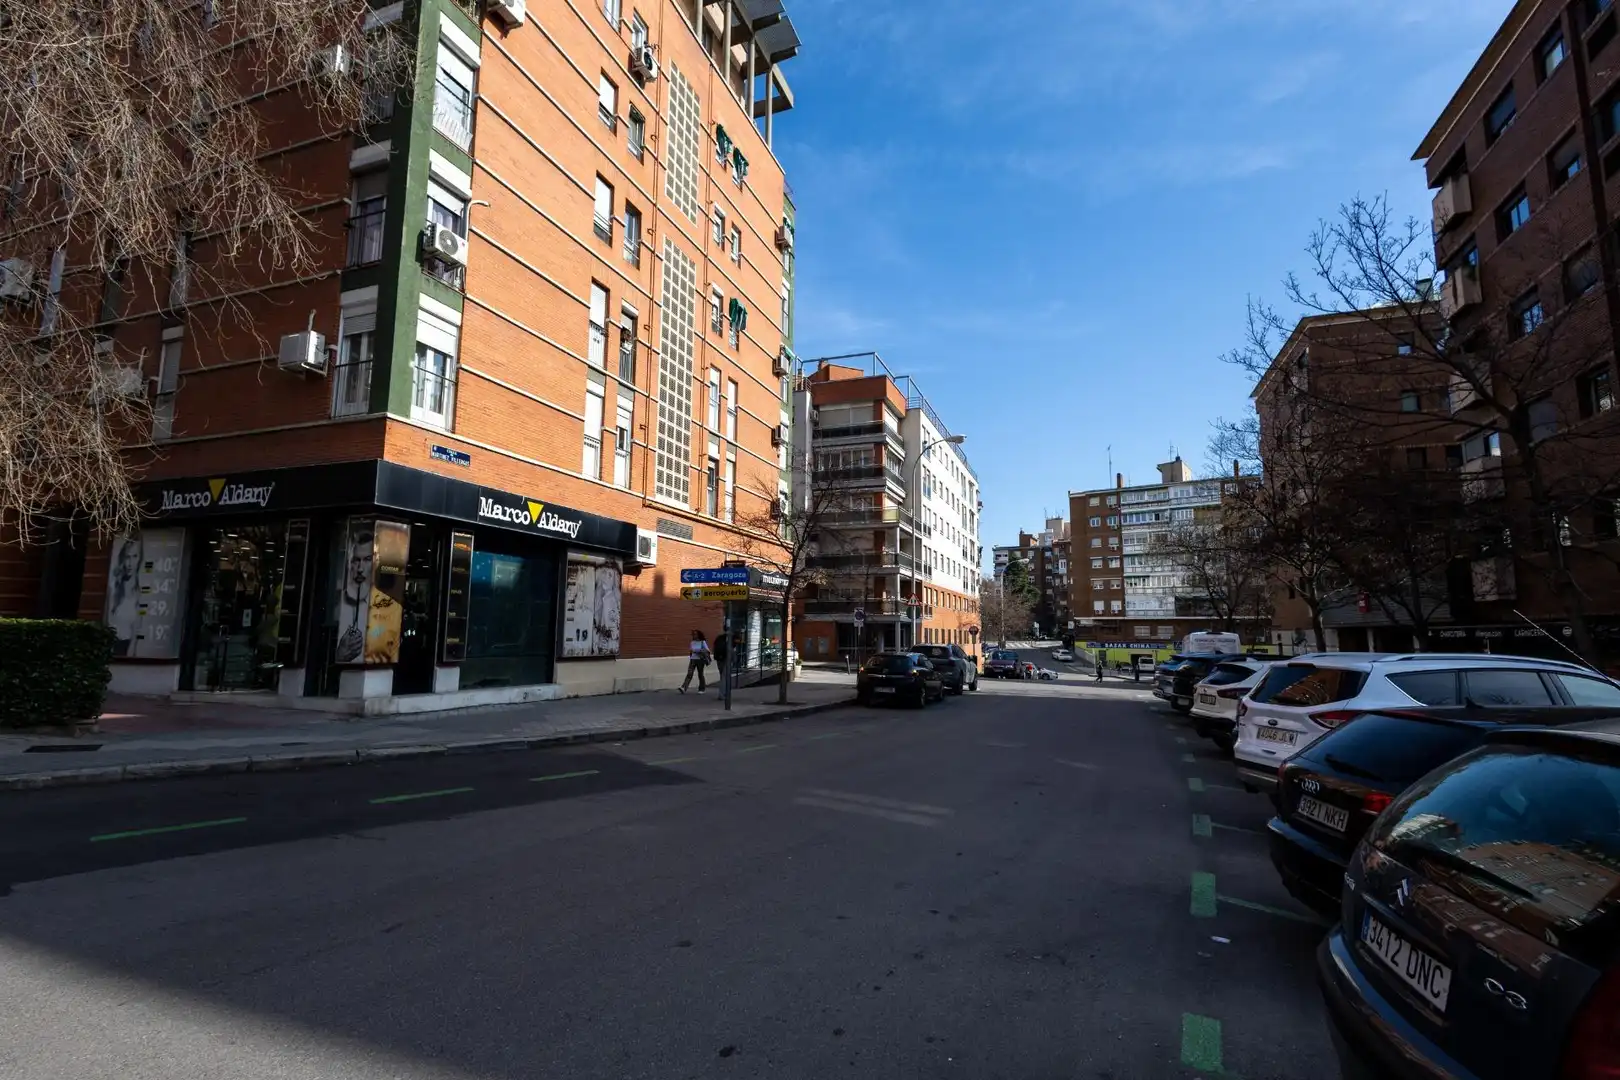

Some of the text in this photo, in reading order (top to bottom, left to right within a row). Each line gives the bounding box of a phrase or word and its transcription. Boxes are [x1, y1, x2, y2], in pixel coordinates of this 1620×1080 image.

[161, 482, 273, 509] Marco Aldany
[479, 496, 581, 538] Marco Aldany
[711, 571, 747, 580] Zaragoza
[703, 590, 747, 598] aeropuerto
[1300, 797, 1347, 829] 3921 NKH
[1368, 915, 1405, 967] 3412
[1406, 944, 1444, 999] DNC
